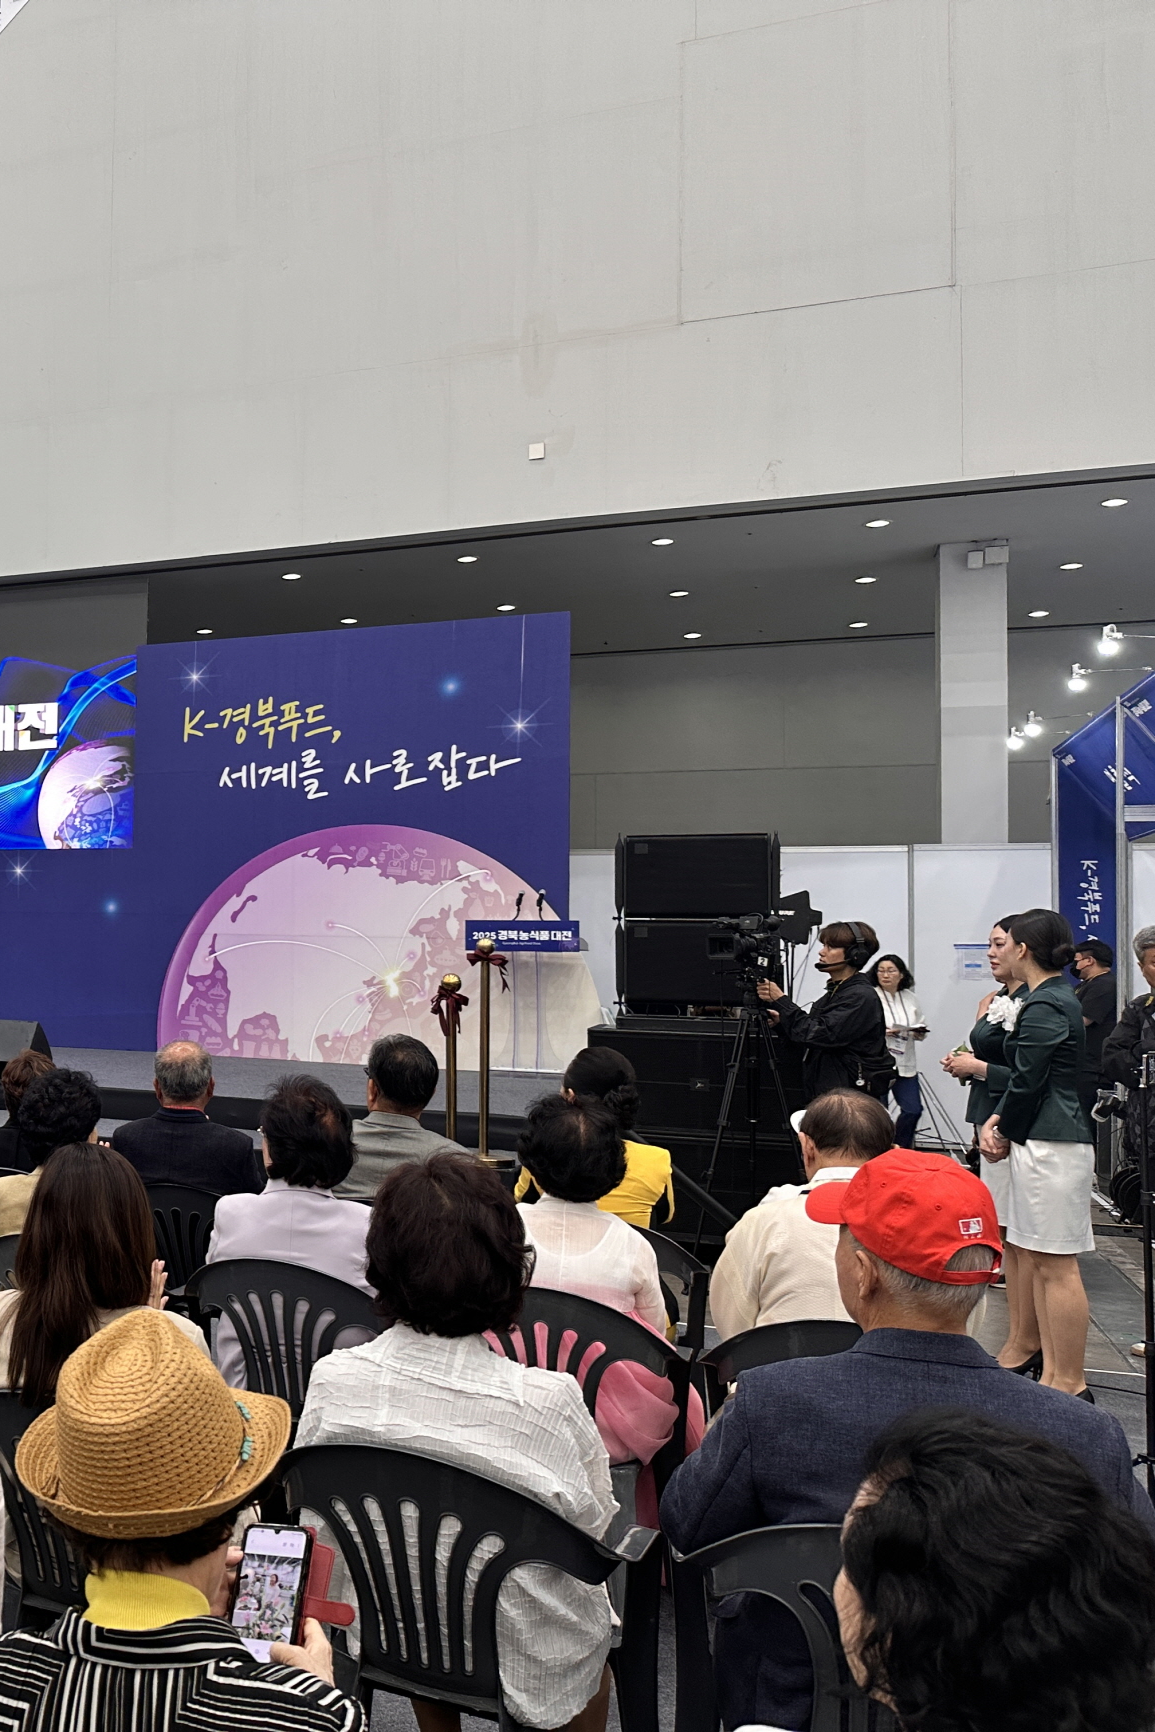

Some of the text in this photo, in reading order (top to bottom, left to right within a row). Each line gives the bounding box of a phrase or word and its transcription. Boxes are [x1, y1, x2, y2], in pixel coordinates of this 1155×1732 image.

[183, 696, 342, 749] K-경북푸드,
[219, 748, 329, 800] 세계를
[1077, 860, 1103, 930] K-경북푸드,
[472, 931, 497, 940] 2025
